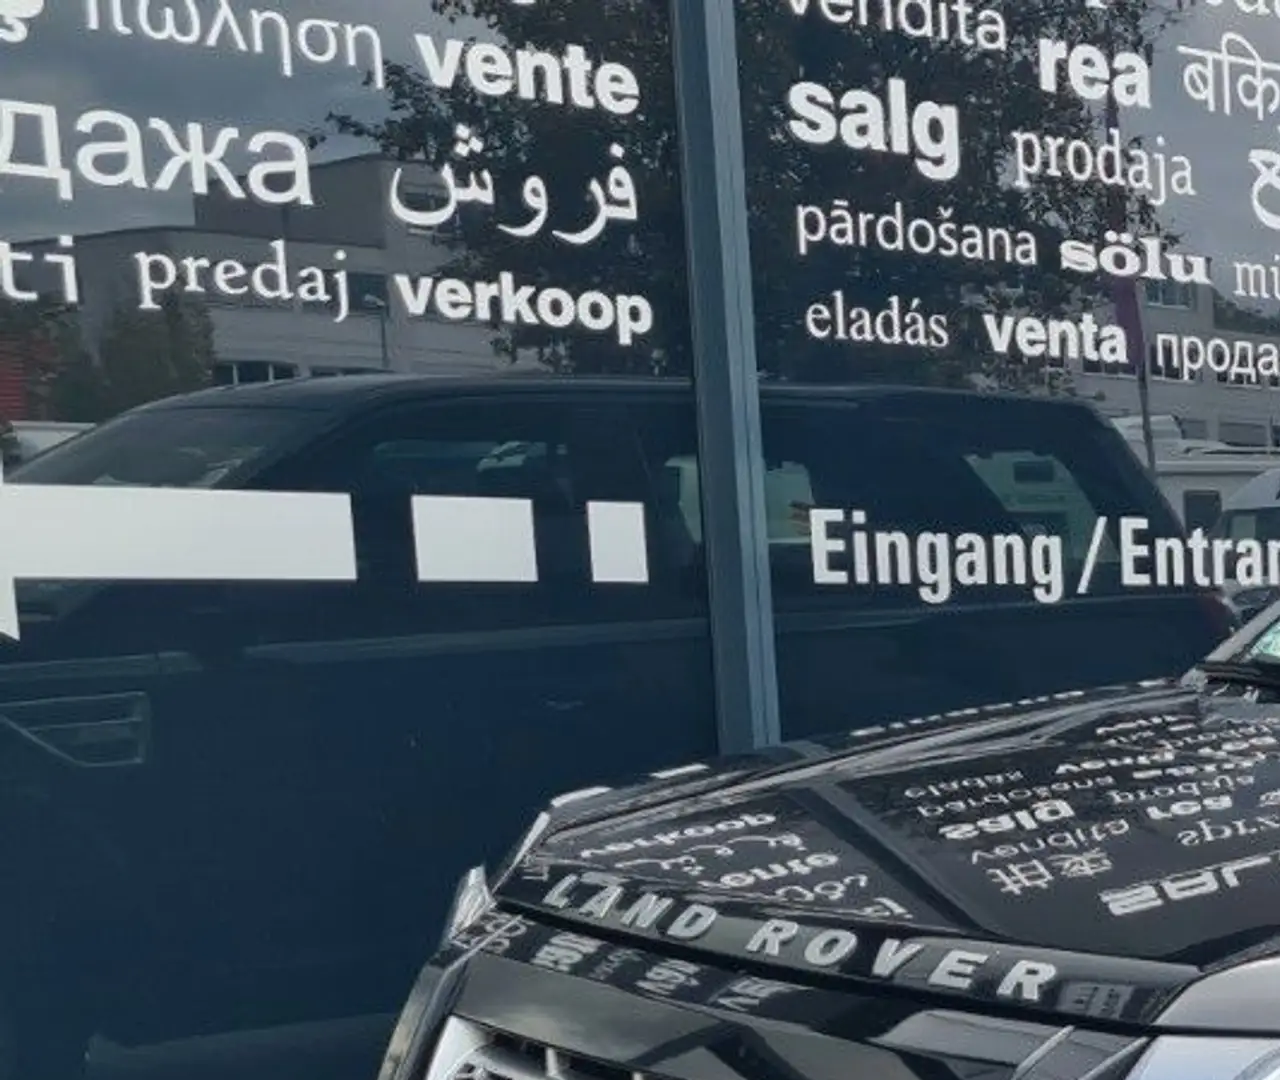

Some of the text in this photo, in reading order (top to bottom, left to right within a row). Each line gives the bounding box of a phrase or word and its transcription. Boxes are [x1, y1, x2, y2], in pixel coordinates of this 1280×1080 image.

[415, 32, 640, 114] vente
[1038, 37, 1151, 108] rea
[789, 78, 960, 180] salg
[1010, 128, 1197, 206] prodaja
[135, 239, 350, 323] predaj
[797, 200, 1038, 267] pārdošana
[1060, 230, 1213, 285] sölu
[395, 271, 653, 345] verkoop
[806, 290, 1128, 364] eladás venta
[809, 509, 1064, 603] Eingang
[543, 871, 718, 942] LAND
[746, 918, 1059, 1001] ROVER
